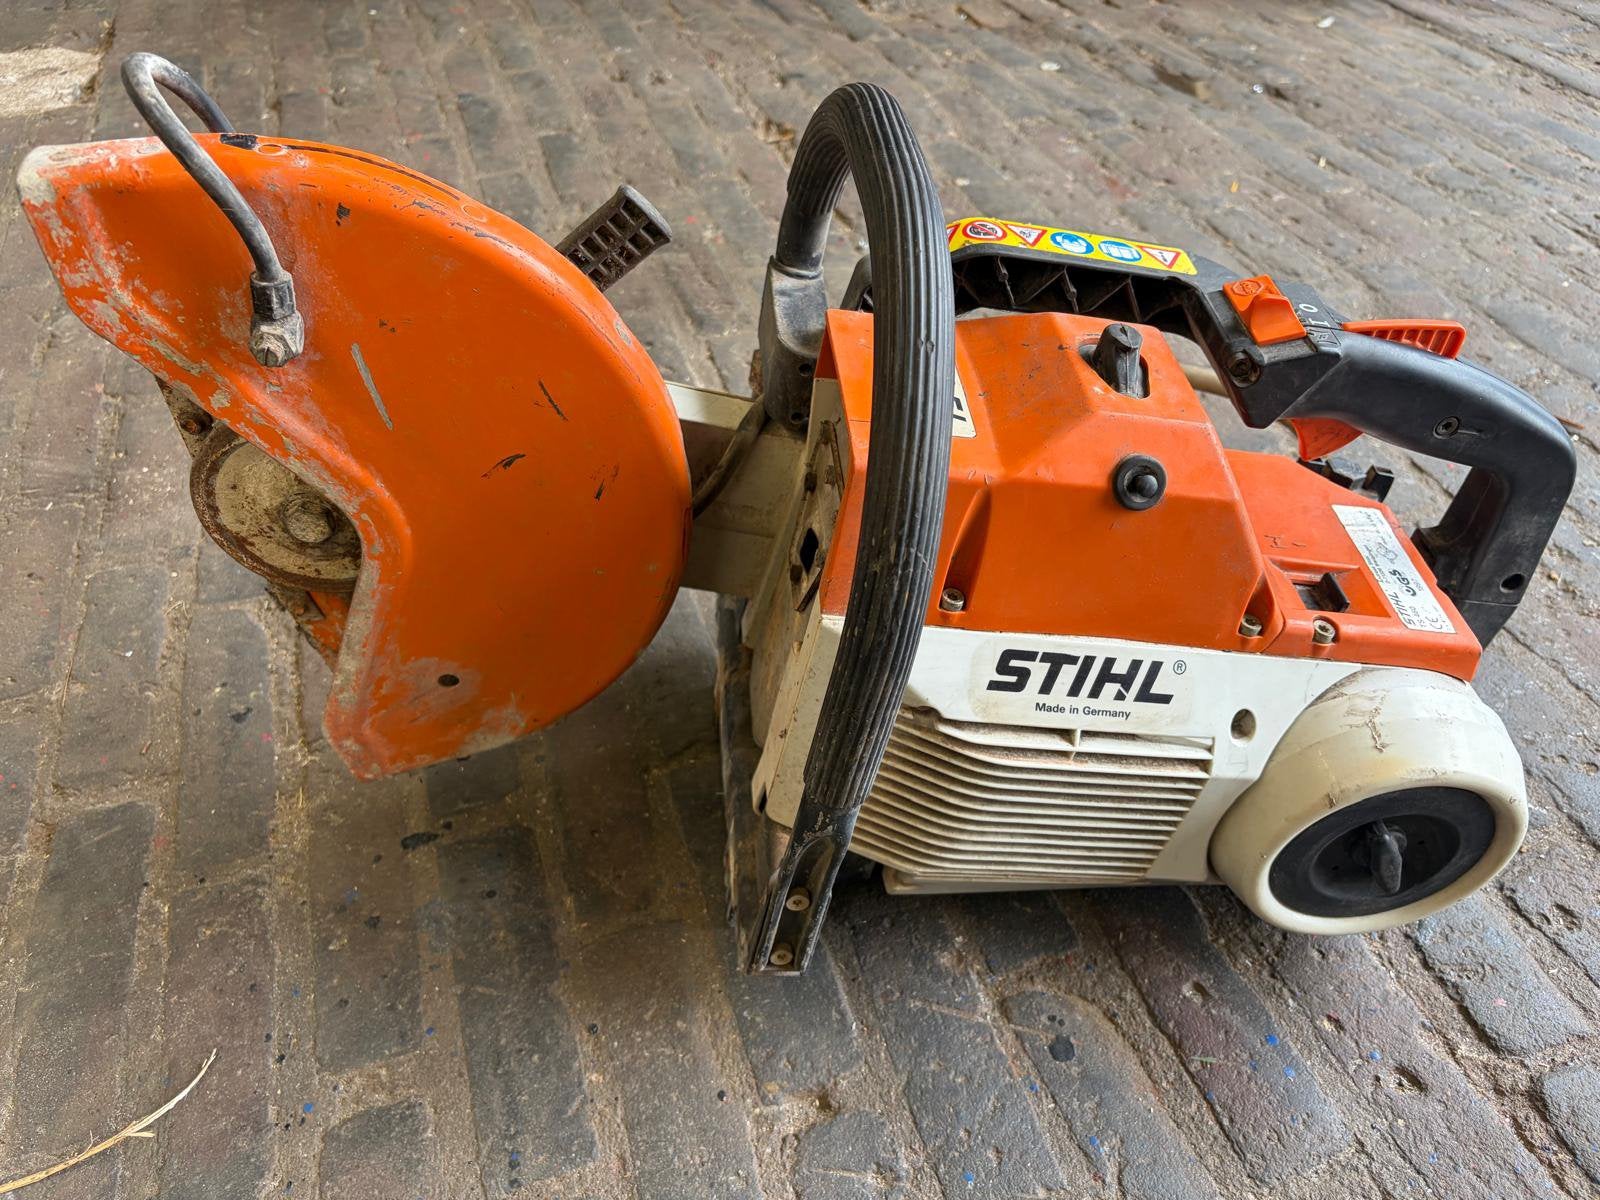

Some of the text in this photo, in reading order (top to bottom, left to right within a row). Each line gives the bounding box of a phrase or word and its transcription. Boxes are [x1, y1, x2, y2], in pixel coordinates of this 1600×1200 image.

[1389, 592, 1416, 625] STIHL
[1034, 701, 1131, 720] Made in Germany
